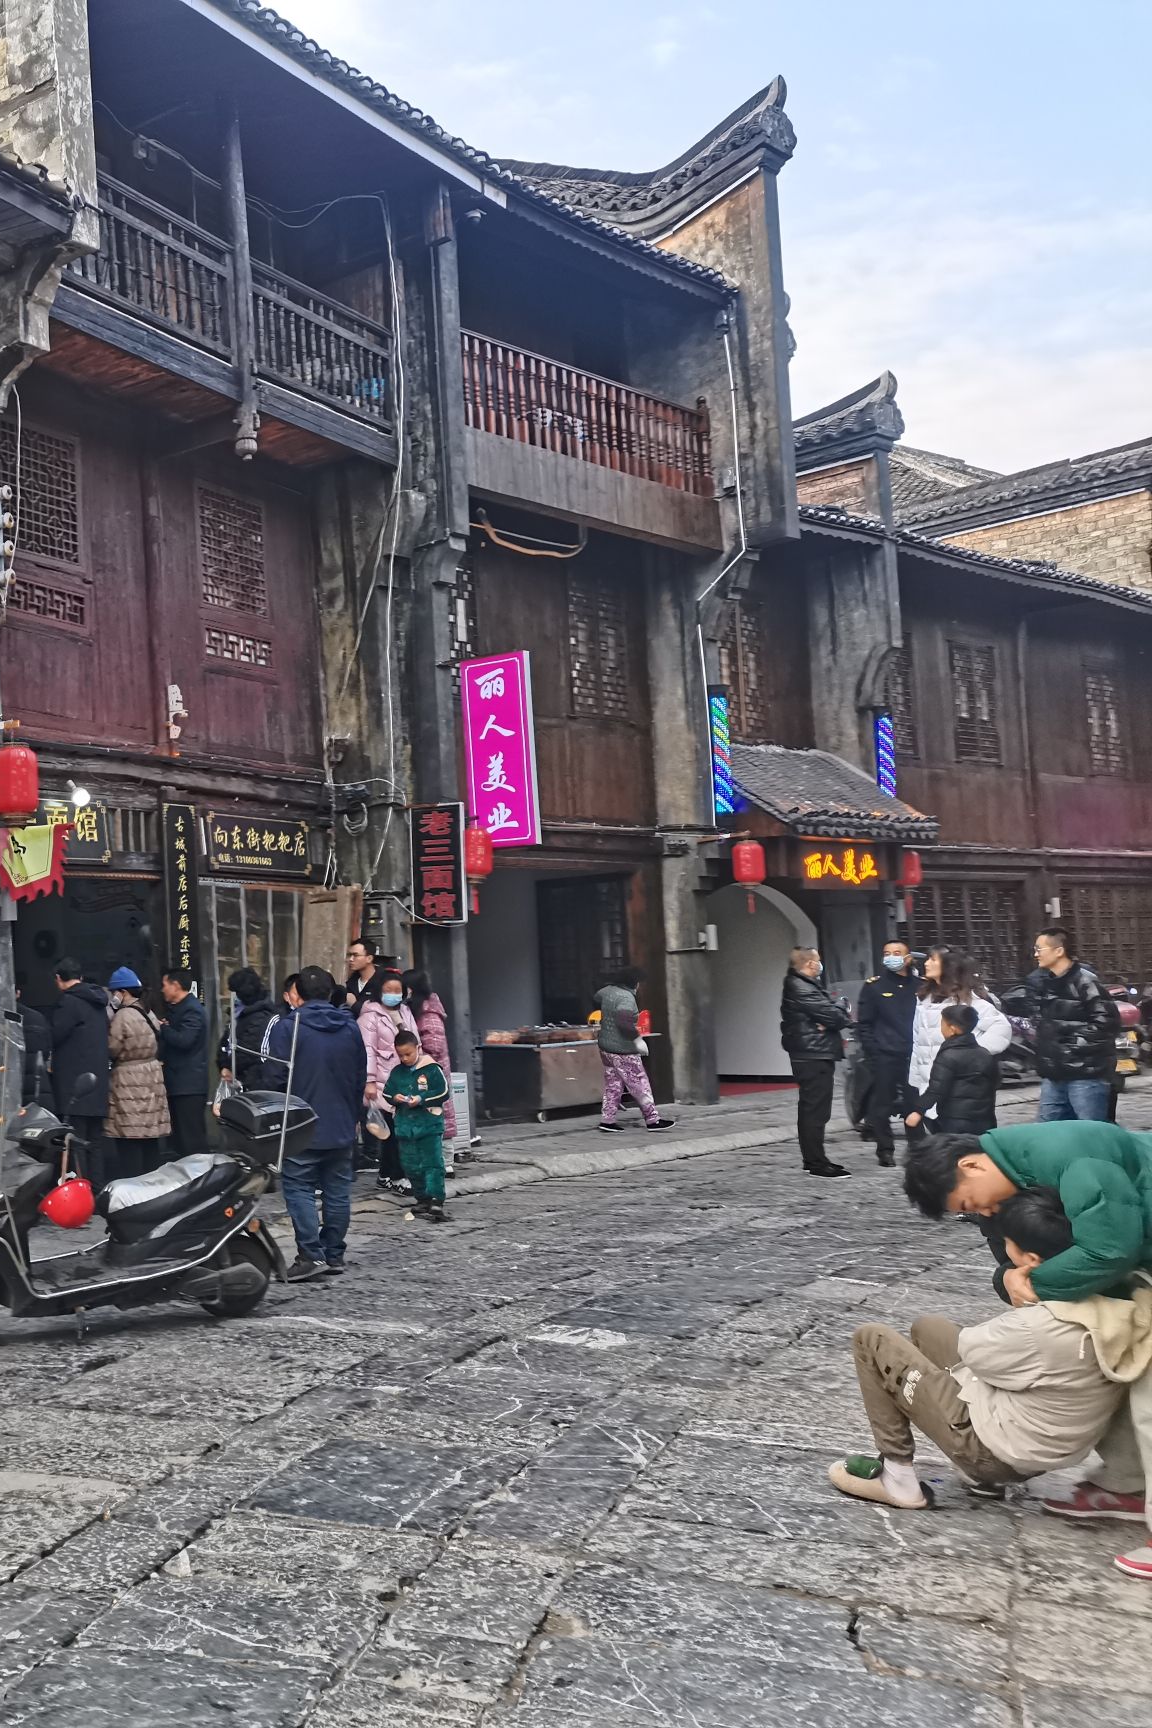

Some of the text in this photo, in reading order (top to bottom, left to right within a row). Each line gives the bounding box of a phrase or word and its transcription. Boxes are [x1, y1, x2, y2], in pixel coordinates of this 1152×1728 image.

[474, 667, 520, 834] 丽人美业
[26, 804, 99, 842] 面馆
[213, 824, 306, 857] 向东街粑粑店
[419, 810, 456, 918] 老三面馆
[804, 848, 878, 885] 丽人美业
